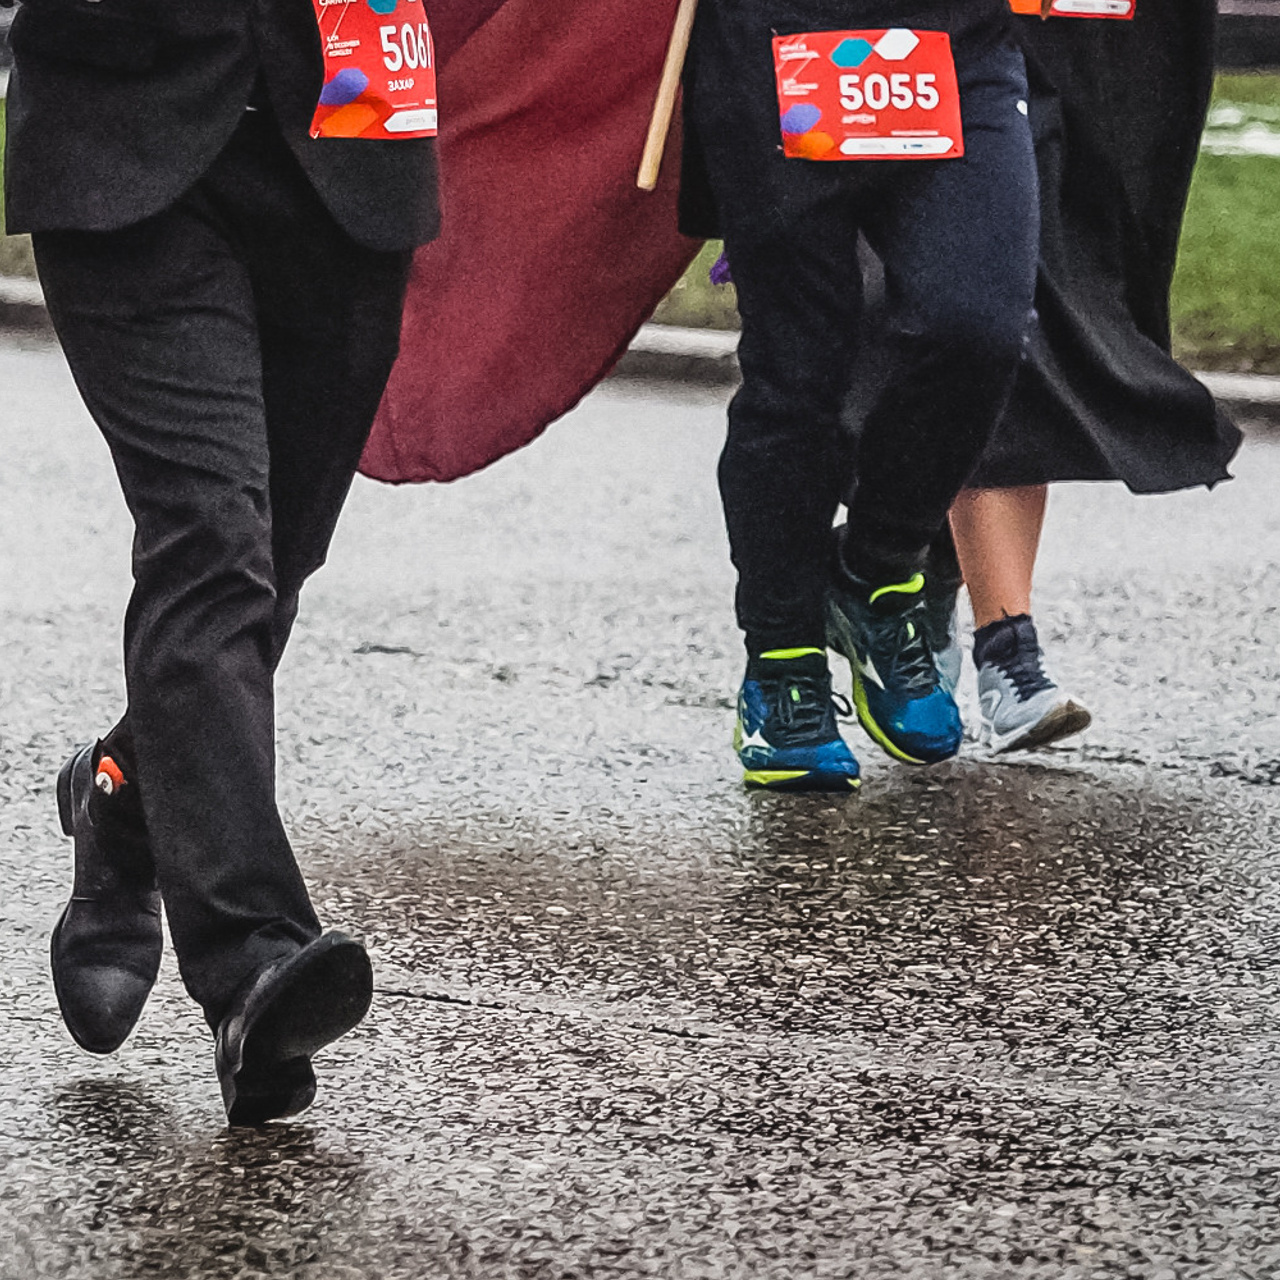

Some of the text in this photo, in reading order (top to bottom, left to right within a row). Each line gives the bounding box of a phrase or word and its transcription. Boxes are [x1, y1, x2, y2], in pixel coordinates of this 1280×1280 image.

[379, 23, 431, 72] 5067
[387, 78, 415, 92] ЗАХАР
[839, 73, 940, 110] 5055
